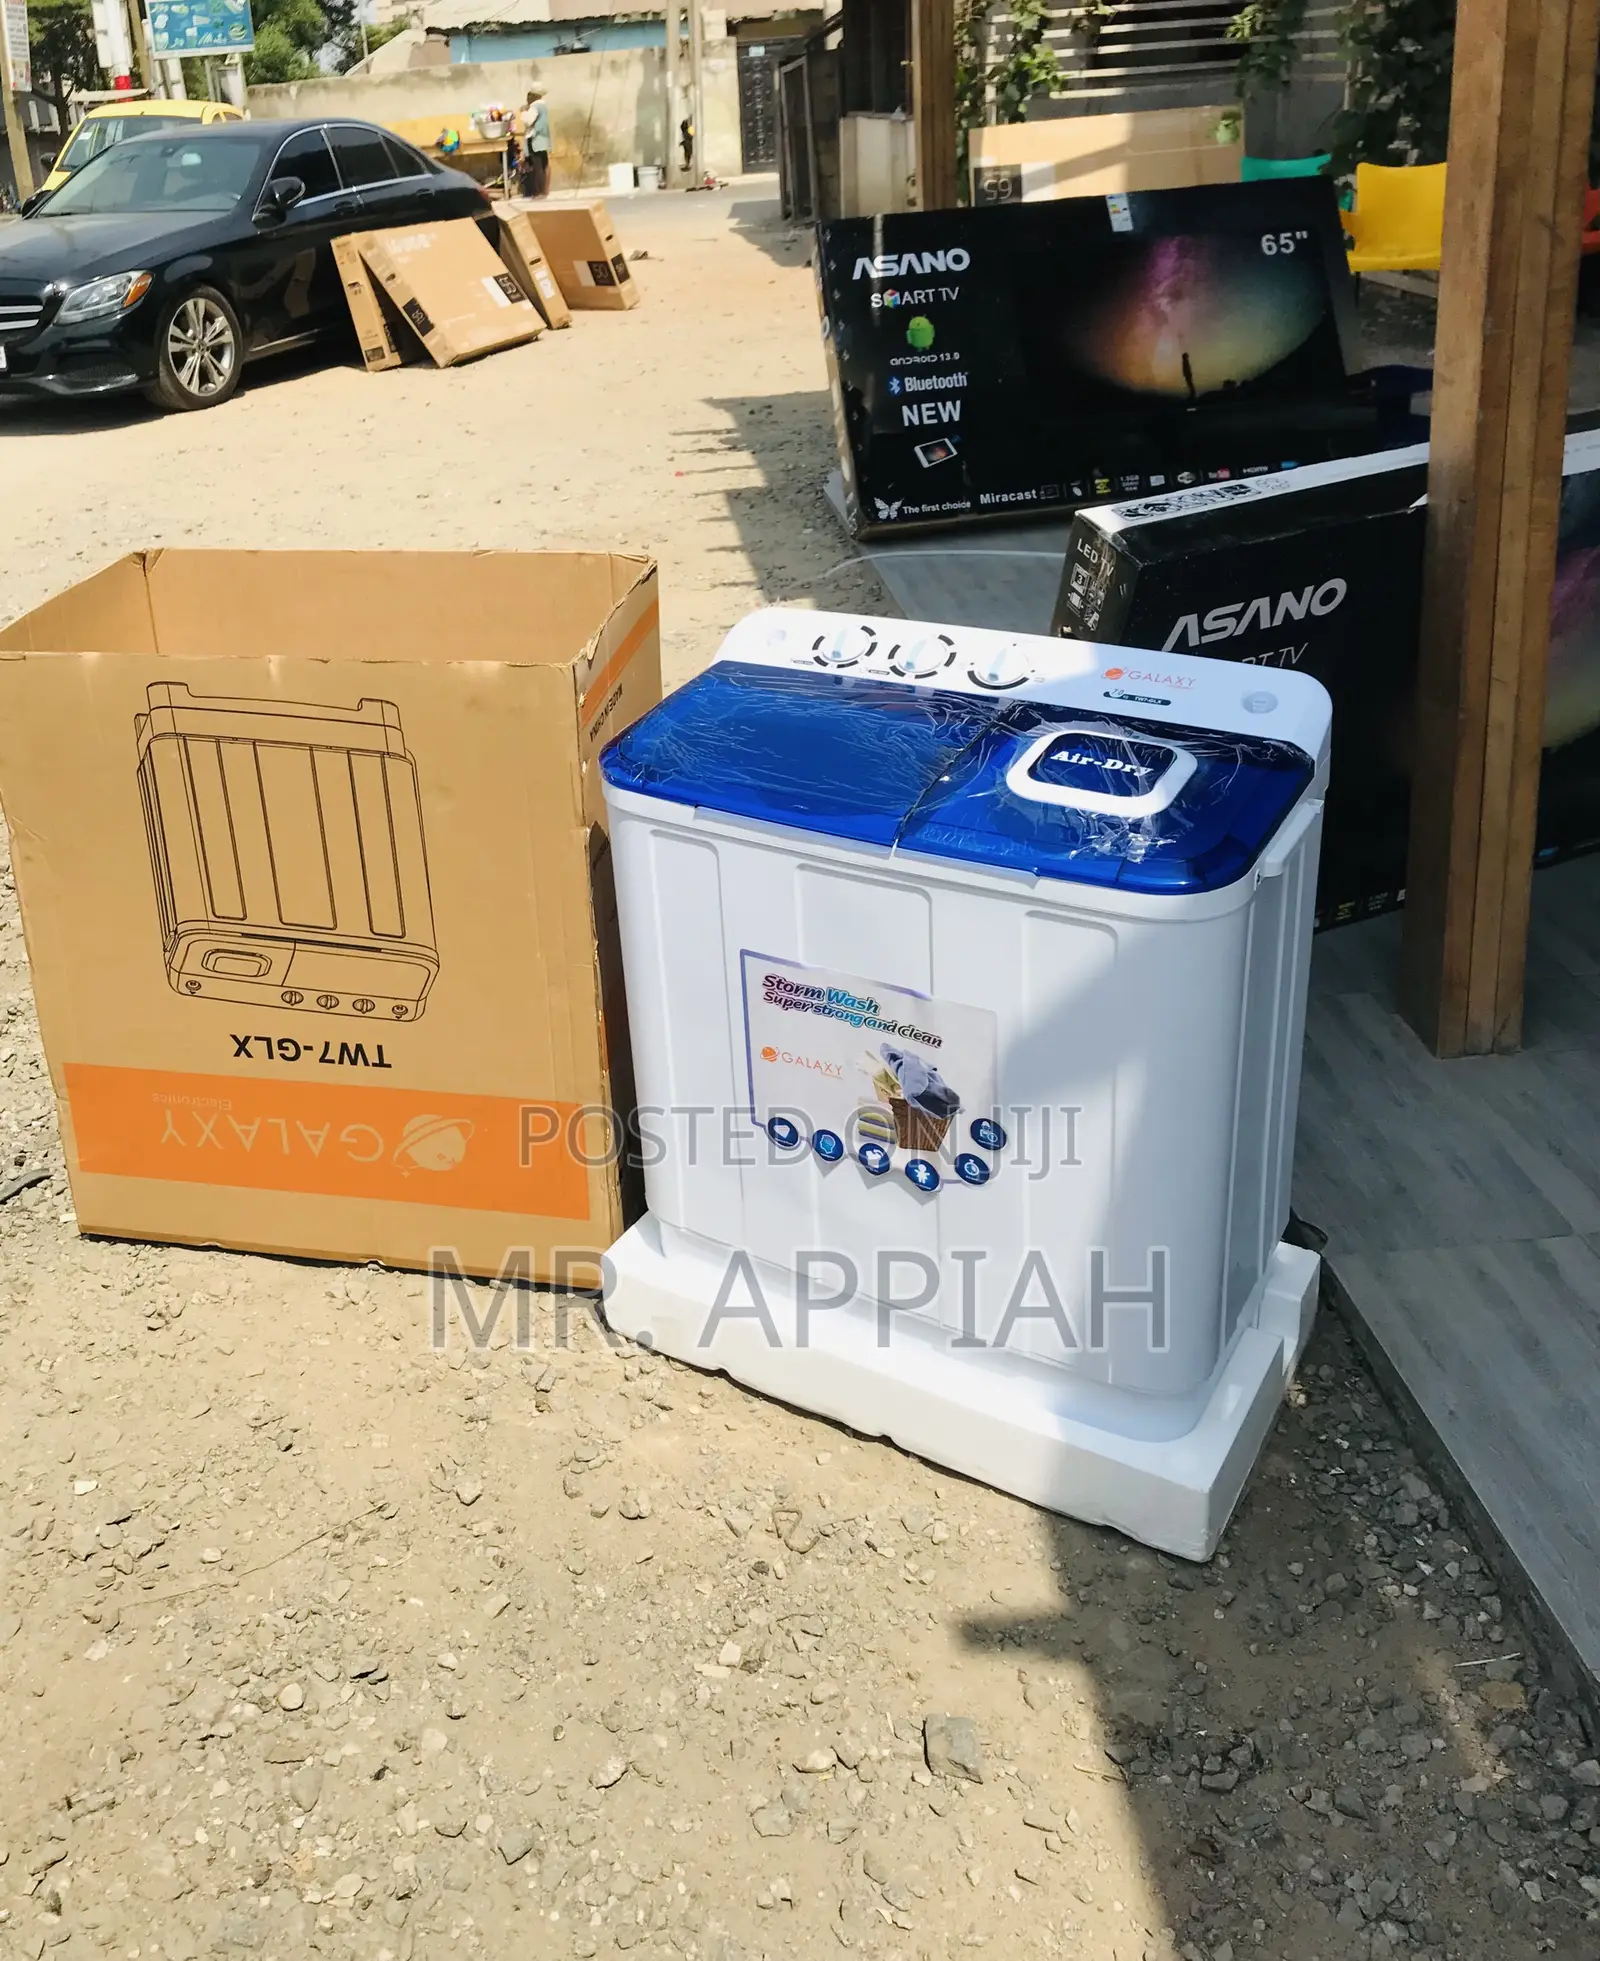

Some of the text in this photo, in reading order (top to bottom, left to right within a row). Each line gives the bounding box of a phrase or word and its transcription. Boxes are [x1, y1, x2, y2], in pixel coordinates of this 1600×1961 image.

[1261, 230, 1308, 256] 65"
[852, 248, 971, 280] ASANO
[938, 286, 960, 301] TV
[904, 371, 968, 392] Bluetooth
[901, 400, 962, 426] NEW
[902, 500, 971, 515] The first choice
[979, 488, 1037, 505] Miracast
[1076, 538, 1115, 577] LED TV
[1161, 577, 1348, 652] ASANO
[1278, 642, 1309, 668] TV
[1127, 671, 1197, 687] GALAXY
[1050, 750, 1154, 777] Air-Dry
[762, 973, 881, 1015] Storm Wash
[763, 991, 943, 1049] Super strong and clean
[229, 1034, 392, 1068] TW7-GLX
[781, 1051, 844, 1076] GALAXY
[151, 1092, 233, 1111] Electronics
[160, 1109, 385, 1162] GALAXY
